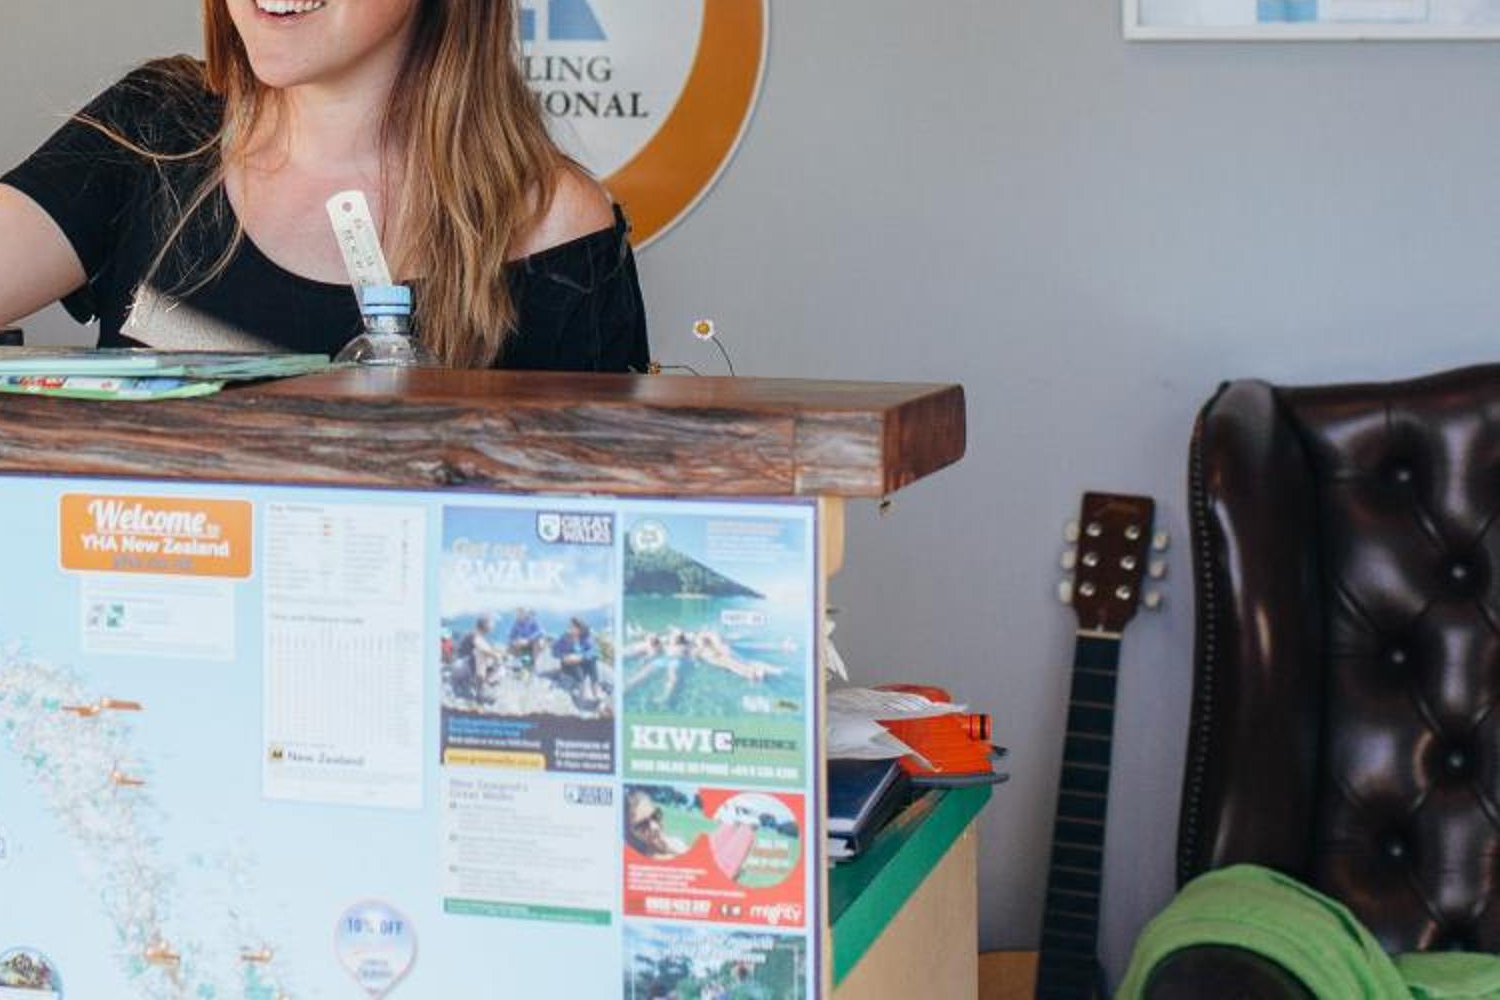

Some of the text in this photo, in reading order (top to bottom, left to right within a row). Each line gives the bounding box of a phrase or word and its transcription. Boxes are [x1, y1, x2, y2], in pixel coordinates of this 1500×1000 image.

[524, 55, 611, 82] LING
[88, 500, 207, 535] Welcome
[81, 534, 230, 558] YHA New Zealand
[631, 725, 713, 752] KIWI
